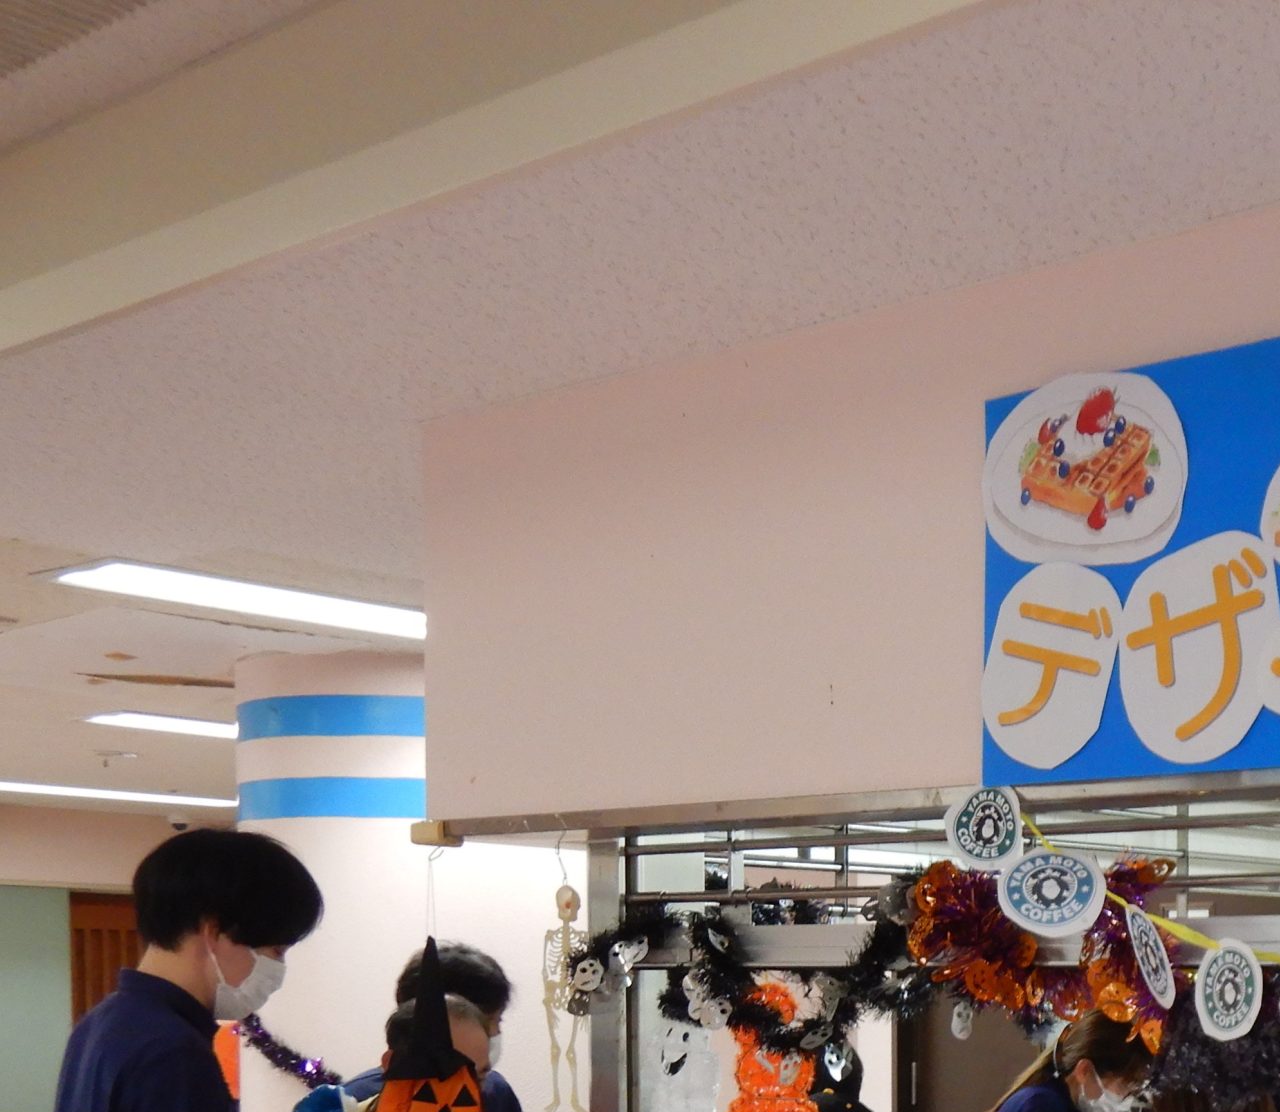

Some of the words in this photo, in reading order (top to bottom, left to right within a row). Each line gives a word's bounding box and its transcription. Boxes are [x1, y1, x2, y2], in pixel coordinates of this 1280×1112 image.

[957, 828, 999, 858] COFFEE
[1020, 899, 1084, 922] COFFEE
[1213, 1002, 1250, 1027] COFFEE
